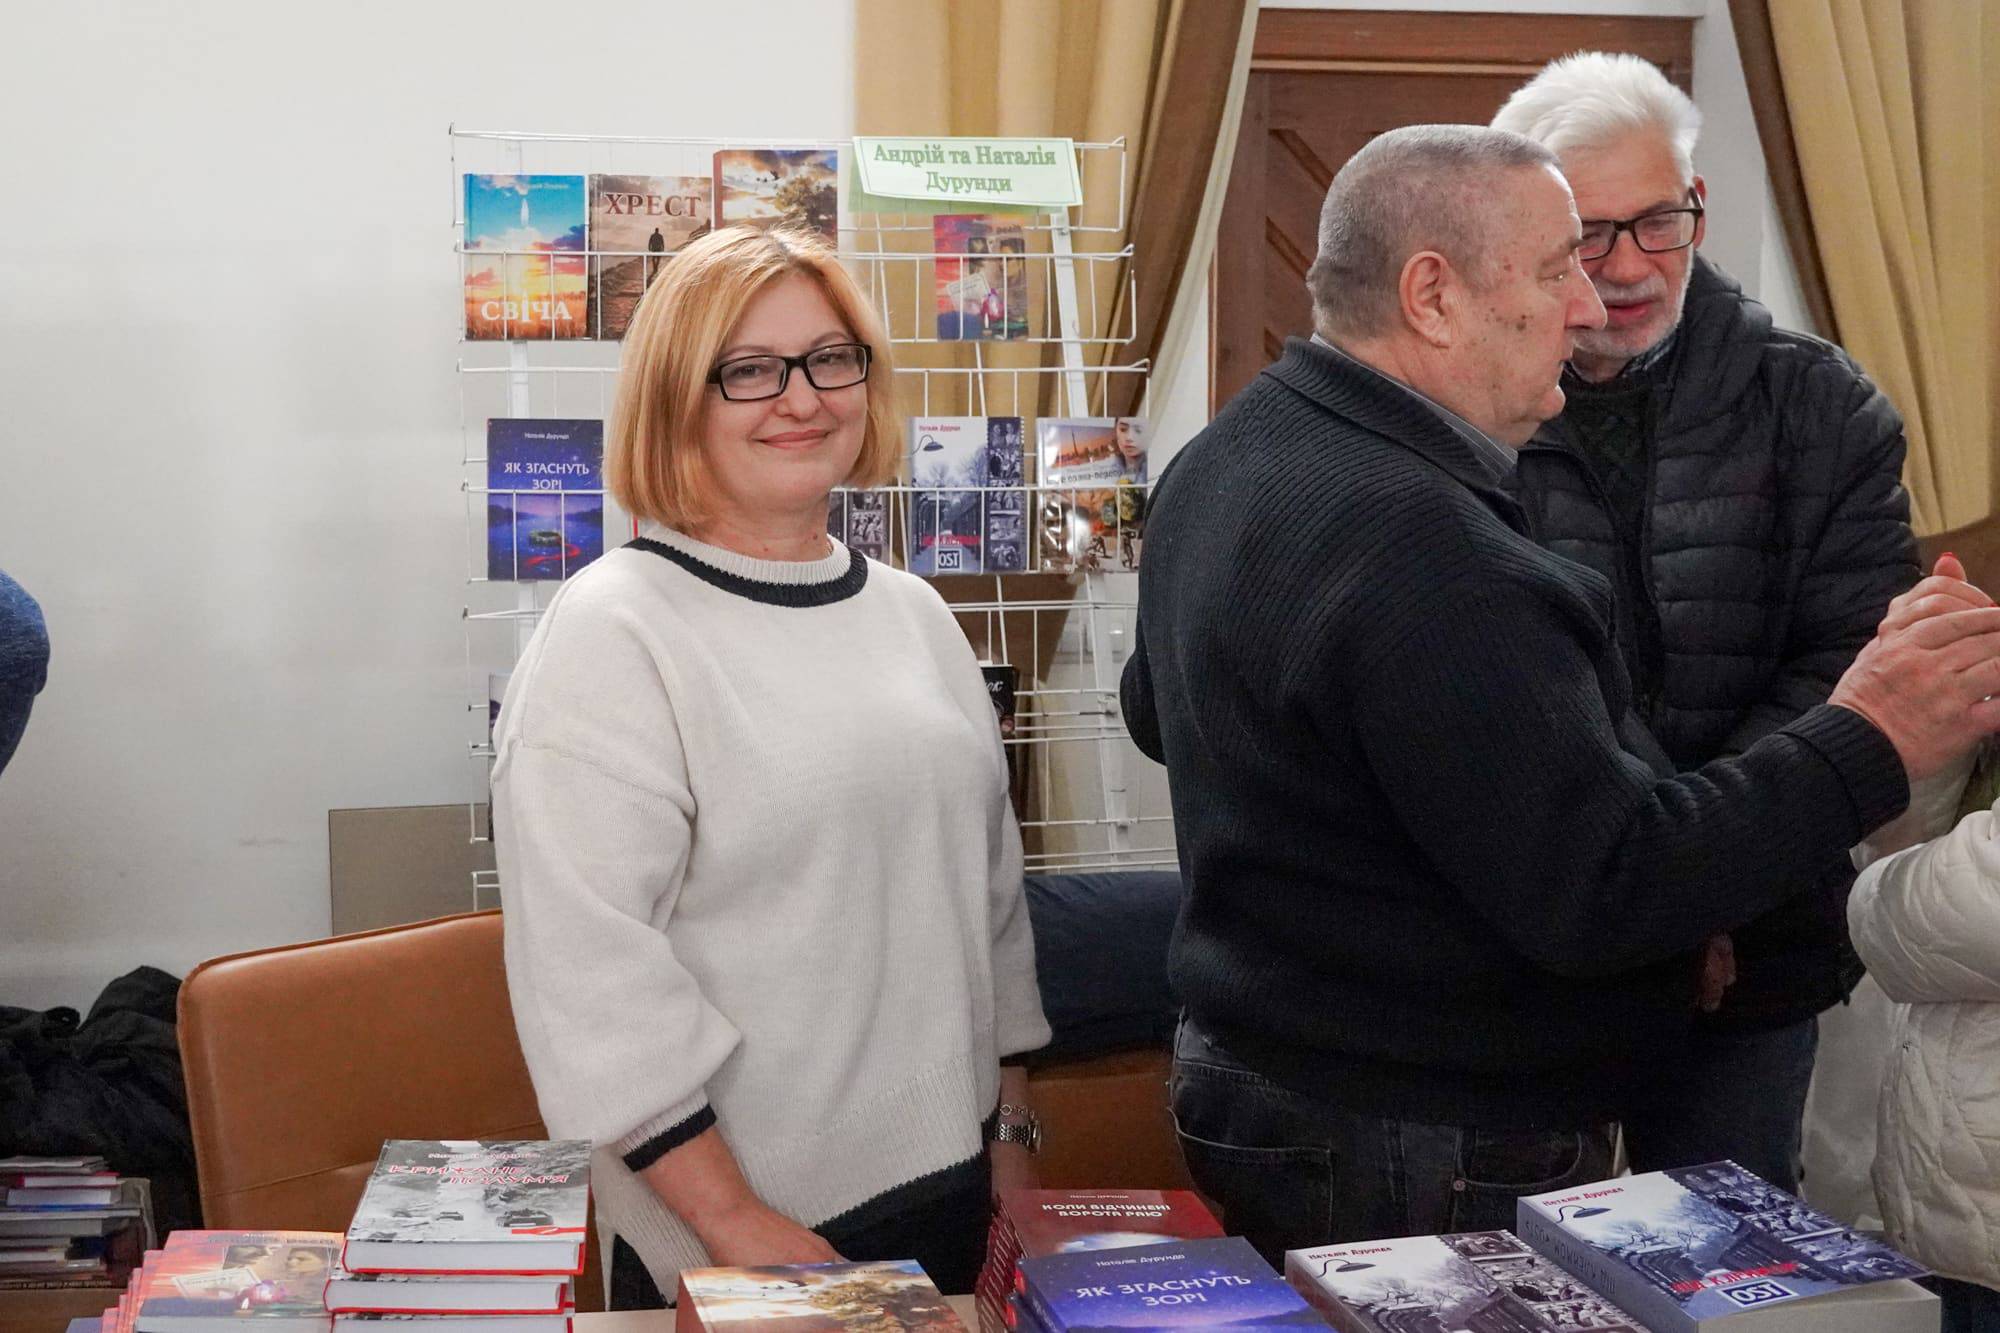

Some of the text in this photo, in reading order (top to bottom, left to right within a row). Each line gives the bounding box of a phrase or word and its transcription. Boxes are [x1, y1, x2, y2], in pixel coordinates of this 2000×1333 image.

[873, 144, 1056, 168] Андрій та Наталія
[926, 171, 1013, 194] Дурунди
[604, 193, 703, 219] ХРЕСТ
[480, 297, 573, 323] СВІЧА
[504, 462, 590, 475] ЯК ЗГАСНУТЬ
[532, 479, 563, 490] ЗОРІ
[938, 552, 959, 567] OST
[1041, 1203, 1172, 1212] КОЛИ ВІДЧИНЕНІ
[1058, 1210, 1122, 1218] ВОРОТА
[1076, 1275, 1252, 1299] ЯК ЗГАСНУТЬ
[1730, 1282, 1783, 1302] OST
[1141, 1292, 1209, 1307] ЗОРІ
